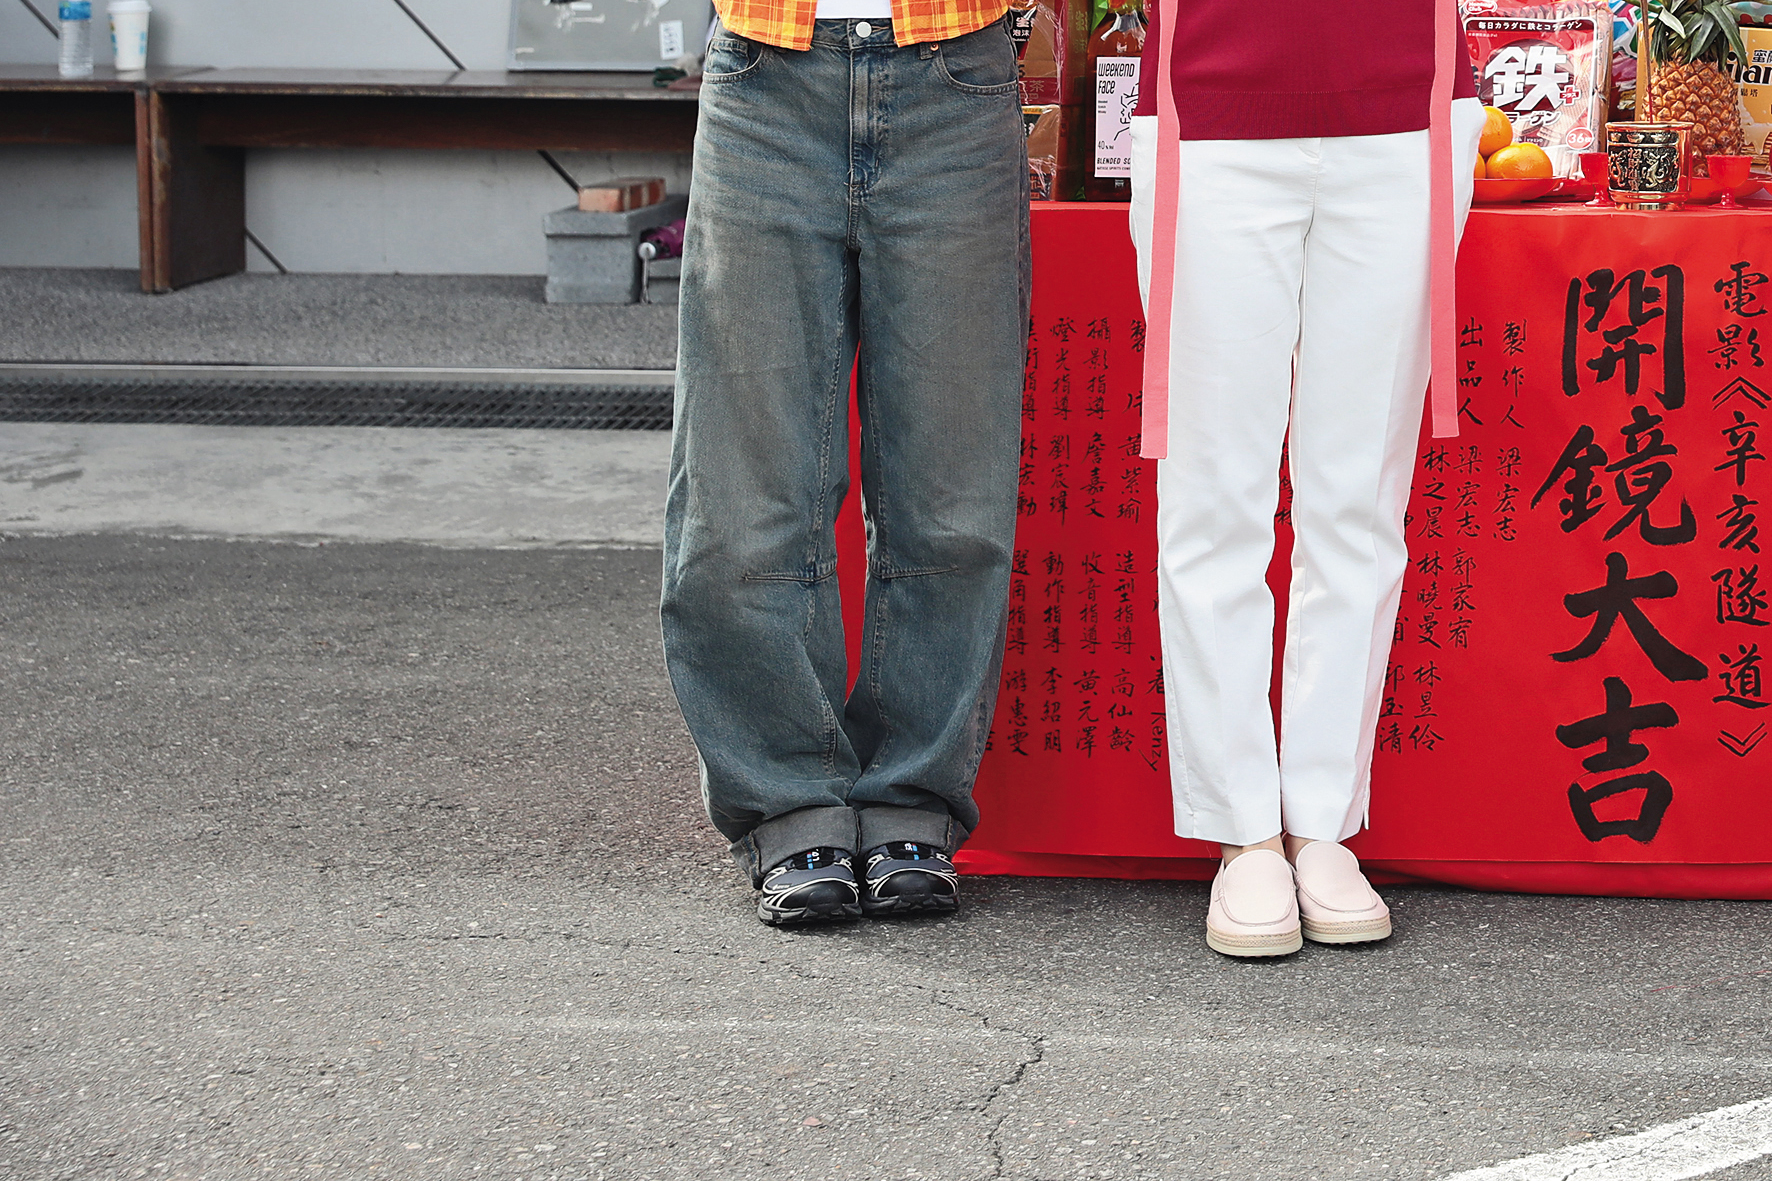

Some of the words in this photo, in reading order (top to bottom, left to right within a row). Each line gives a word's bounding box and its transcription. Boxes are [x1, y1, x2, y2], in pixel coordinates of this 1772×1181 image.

[1485, 45, 1569, 111] 鉄
[1505, 110, 1560, 126] ラーゲン
[1097, 157, 1121, 165] BLENDED
[1050, 317, 1077, 421] 燈光指導
[1083, 317, 1111, 419] 攝影指導
[1457, 317, 1484, 426] 出品人
[1500, 319, 1527, 429] 製作人
[1079, 432, 1107, 519] 詹嘉文
[1416, 445, 1451, 539] 林之晨
[1453, 446, 1483, 537] 梁宏志
[1493, 447, 1523, 541] 梁宏志
[1706, 261, 1772, 759] 電影《辛亥隧道》
[1042, 551, 1066, 653] 動作指導
[1078, 551, 1105, 654] 收音指導
[1111, 550, 1138, 654] 造型指導
[1416, 550, 1444, 649] 林曉曼
[1447, 547, 1477, 649] 郭家宥
[1530, 264, 1710, 845] 開鏡大吉
[1040, 667, 1062, 753] 李紹明
